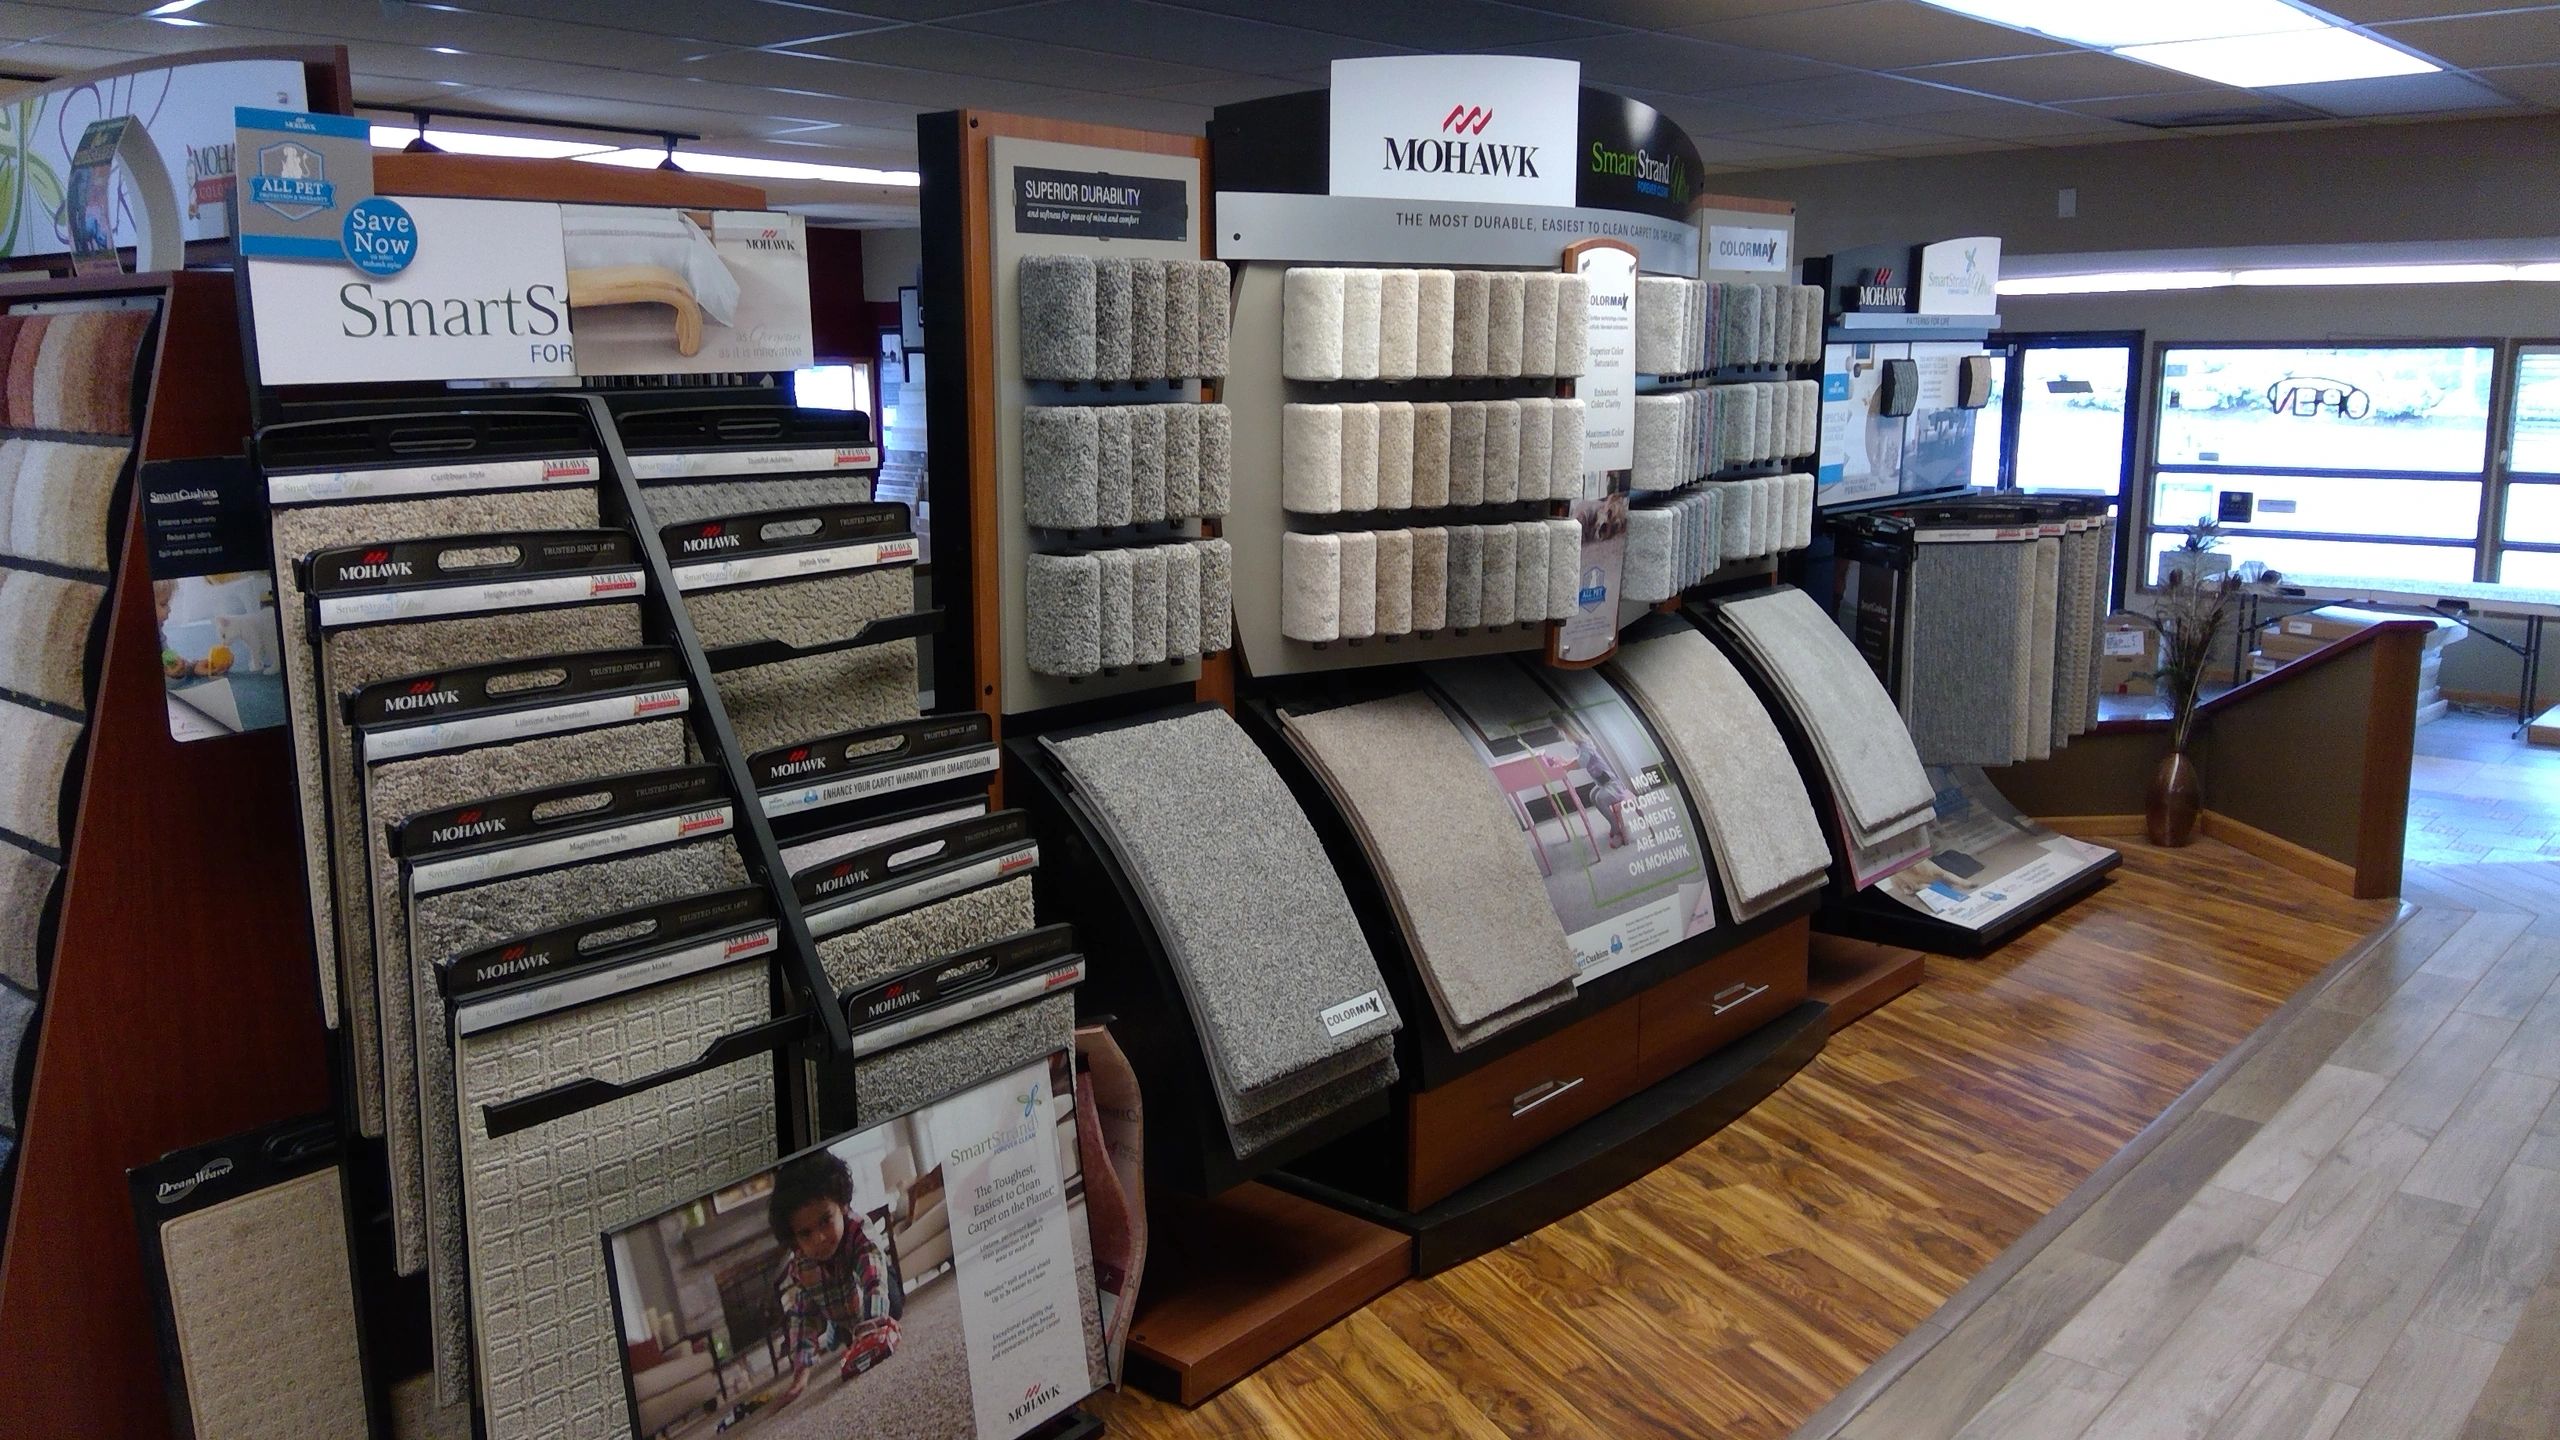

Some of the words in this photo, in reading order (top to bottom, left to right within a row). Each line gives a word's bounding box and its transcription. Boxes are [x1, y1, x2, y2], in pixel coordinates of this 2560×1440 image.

[1382, 136, 1540, 179] MOHAWK
[1592, 140, 1670, 185] SmartStrand
[262, 179, 293, 194] ALL
[295, 182, 323, 195] PET
[1025, 180, 1079, 202] SUPERIOR
[1081, 185, 1141, 206] DURABILITY
[353, 208, 409, 232] Save
[1396, 212, 1423, 226] THE
[1429, 214, 1469, 228] MOST
[1474, 215, 1537, 232] DURABLE,
[1542, 218, 1584, 232] EASIEST
[1588, 221, 1600, 234] TO
[1602, 222, 1629, 236] CLEAN
[1630, 224, 1652, 239] CARPET
[354, 231, 410, 255] Now
[746, 238, 795, 251] MOHAWK
[1720, 238, 1777, 264] COLORMAX
[1590, 292, 1629, 311] OLORMAX
[1859, 286, 1907, 306] MOHAWK
[531, 344, 574, 363] FOR
[431, 472, 466, 483] Caribbean
[468, 470, 485, 481] Style
[150, 488, 218, 503] SmartCushion
[544, 547, 576, 556] TRUSTED
[577, 544, 598, 553] SINCE
[683, 534, 740, 552] MOHAWK
[339, 562, 413, 581] MOHAWK
[484, 589, 508, 600] Height
[517, 587, 533, 598] Style
[590, 665, 622, 676] TRUSTED
[623, 663, 645, 671] SINCE
[385, 691, 459, 711] MOHAWK
[924, 730, 948, 740] TRUSTED
[770, 757, 826, 778] MOHAWK
[823, 782, 852, 800] ENHANCE
[853, 779, 871, 793] YOUR
[871, 775, 896, 790] CARPET
[896, 769, 929, 785] WARRANTY
[930, 765, 946, 778] WITH
[947, 755, 991, 773] SMARTCUSHION
[635, 785, 668, 797] TRUSTED
[669, 781, 690, 791] SINCE
[1631, 770, 1661, 792] MORE
[1620, 789, 1671, 814] COLORFUL
[432, 818, 507, 843] MOHAWK
[1628, 806, 1677, 833] MOMENTS
[1636, 831, 1658, 852] ARE
[1657, 825, 1684, 848] MADE
[1628, 856, 1651, 876] ON
[1650, 844, 1690, 871] MOHAWK
[815, 869, 870, 895] MOHAWK
[679, 910, 712, 924] TRUSTED
[712, 905, 733, 915] SINCE
[476, 952, 550, 983] MOHAWK
[651, 960, 672, 971] Maker
[868, 989, 921, 1018] MOHAWK
[1326, 996, 1380, 1027] COLORMAX
[951, 1113, 1039, 1167] SmartStrand
[993, 1140, 1018, 1156] FOREVER
[1018, 1131, 1037, 1145] CLEAN
[974, 1182, 992, 1200] The
[993, 1164, 1037, 1189] Toughest,
[973, 1196, 1005, 1217] Easiest
[1005, 1190, 1015, 1200] to
[1015, 1177, 1041, 1196] Clean
[967, 1214, 997, 1236] Carpet
[999, 1210, 1011, 1222] on
[1011, 1199, 1025, 1214] the
[1007, 1384, 1061, 1425] MOHAWK
